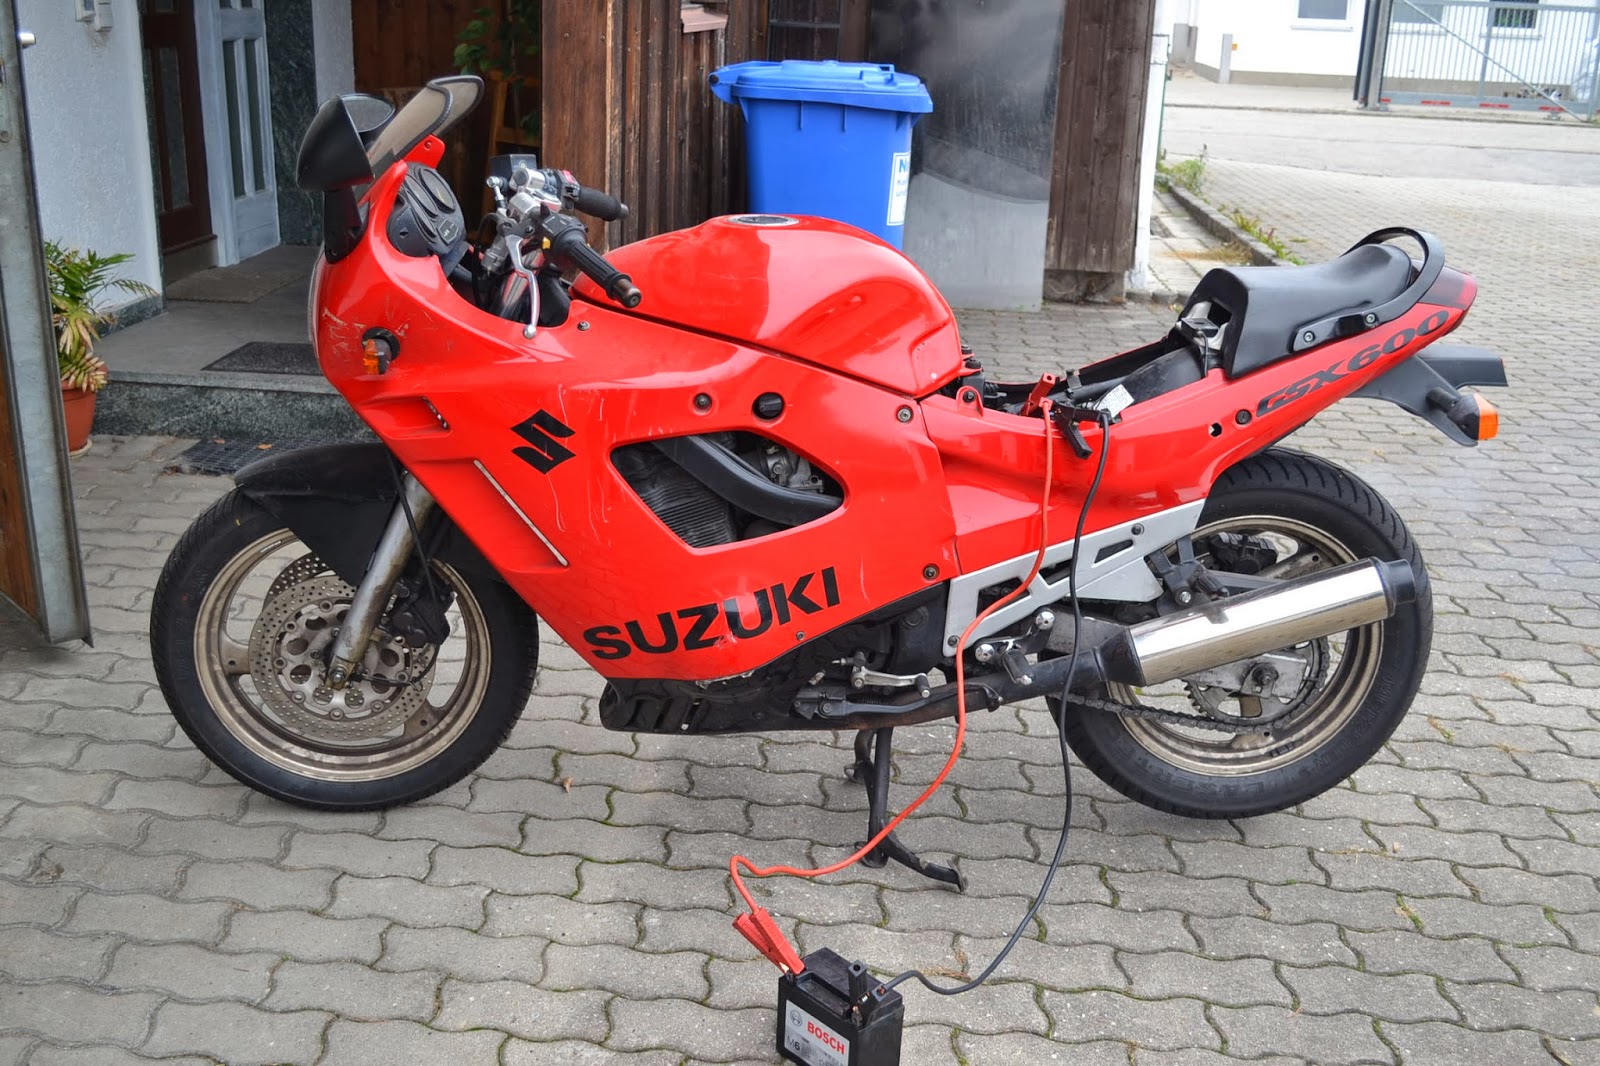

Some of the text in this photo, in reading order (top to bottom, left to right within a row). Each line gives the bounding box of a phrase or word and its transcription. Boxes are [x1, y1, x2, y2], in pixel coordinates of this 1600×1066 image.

[1256, 310, 1449, 417] GSX600
[583, 566, 841, 660] SUZUKI
[807, 1021, 845, 1055] BOSCH
